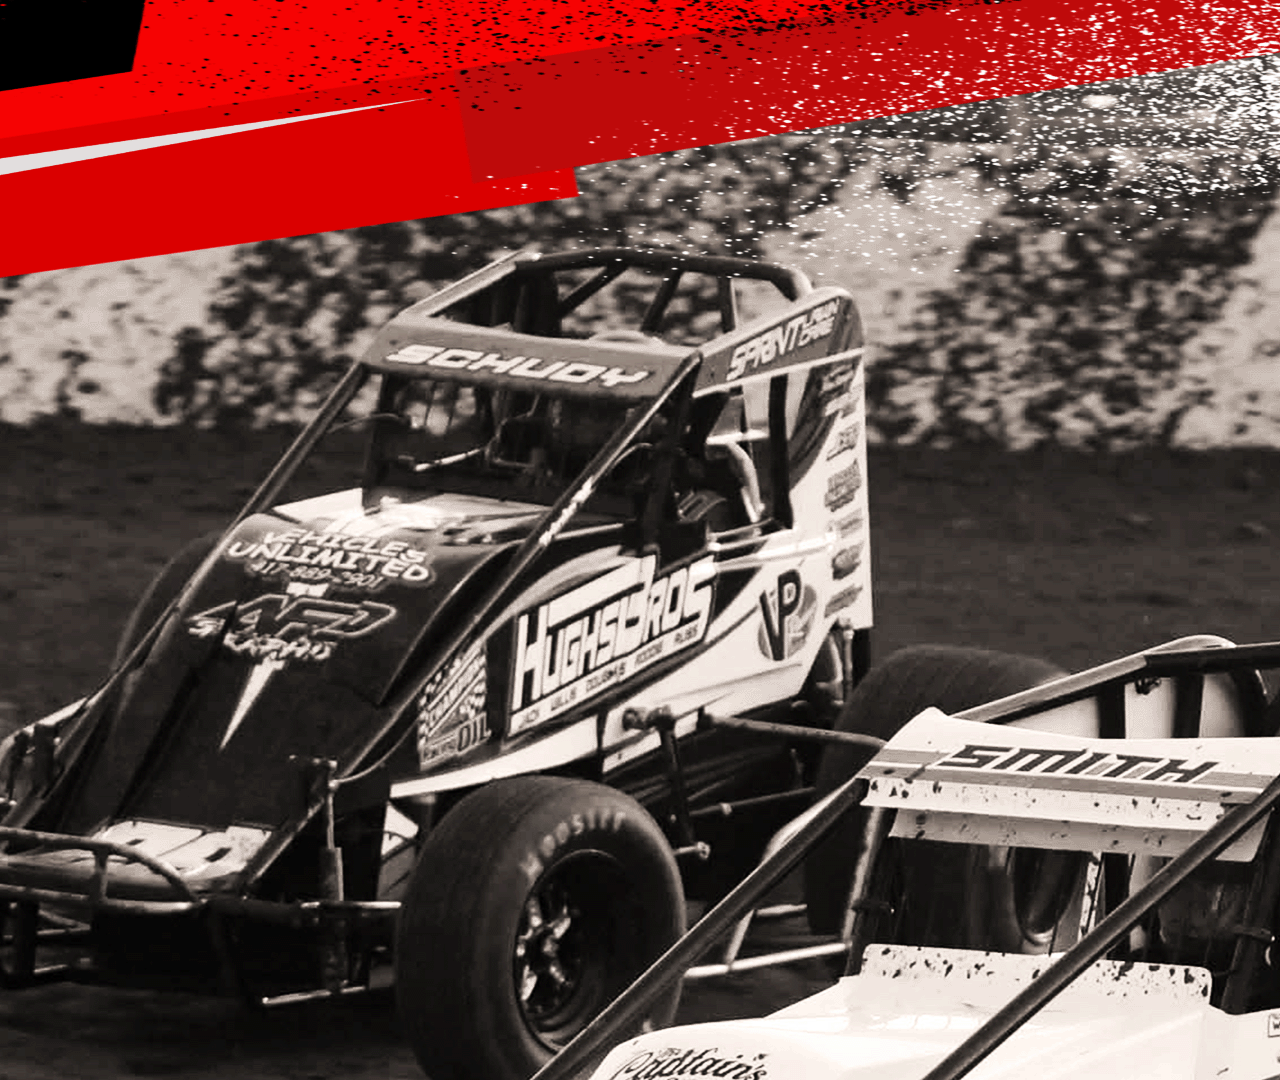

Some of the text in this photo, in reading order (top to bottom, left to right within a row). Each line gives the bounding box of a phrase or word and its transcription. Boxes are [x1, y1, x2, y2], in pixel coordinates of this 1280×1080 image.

[386, 343, 650, 387] SCHUDY
[227, 541, 430, 582] UNLIMITED
[262, 529, 429, 564] VEHICLES
[759, 568, 803, 662] VP
[936, 744, 1219, 784] SMITH
